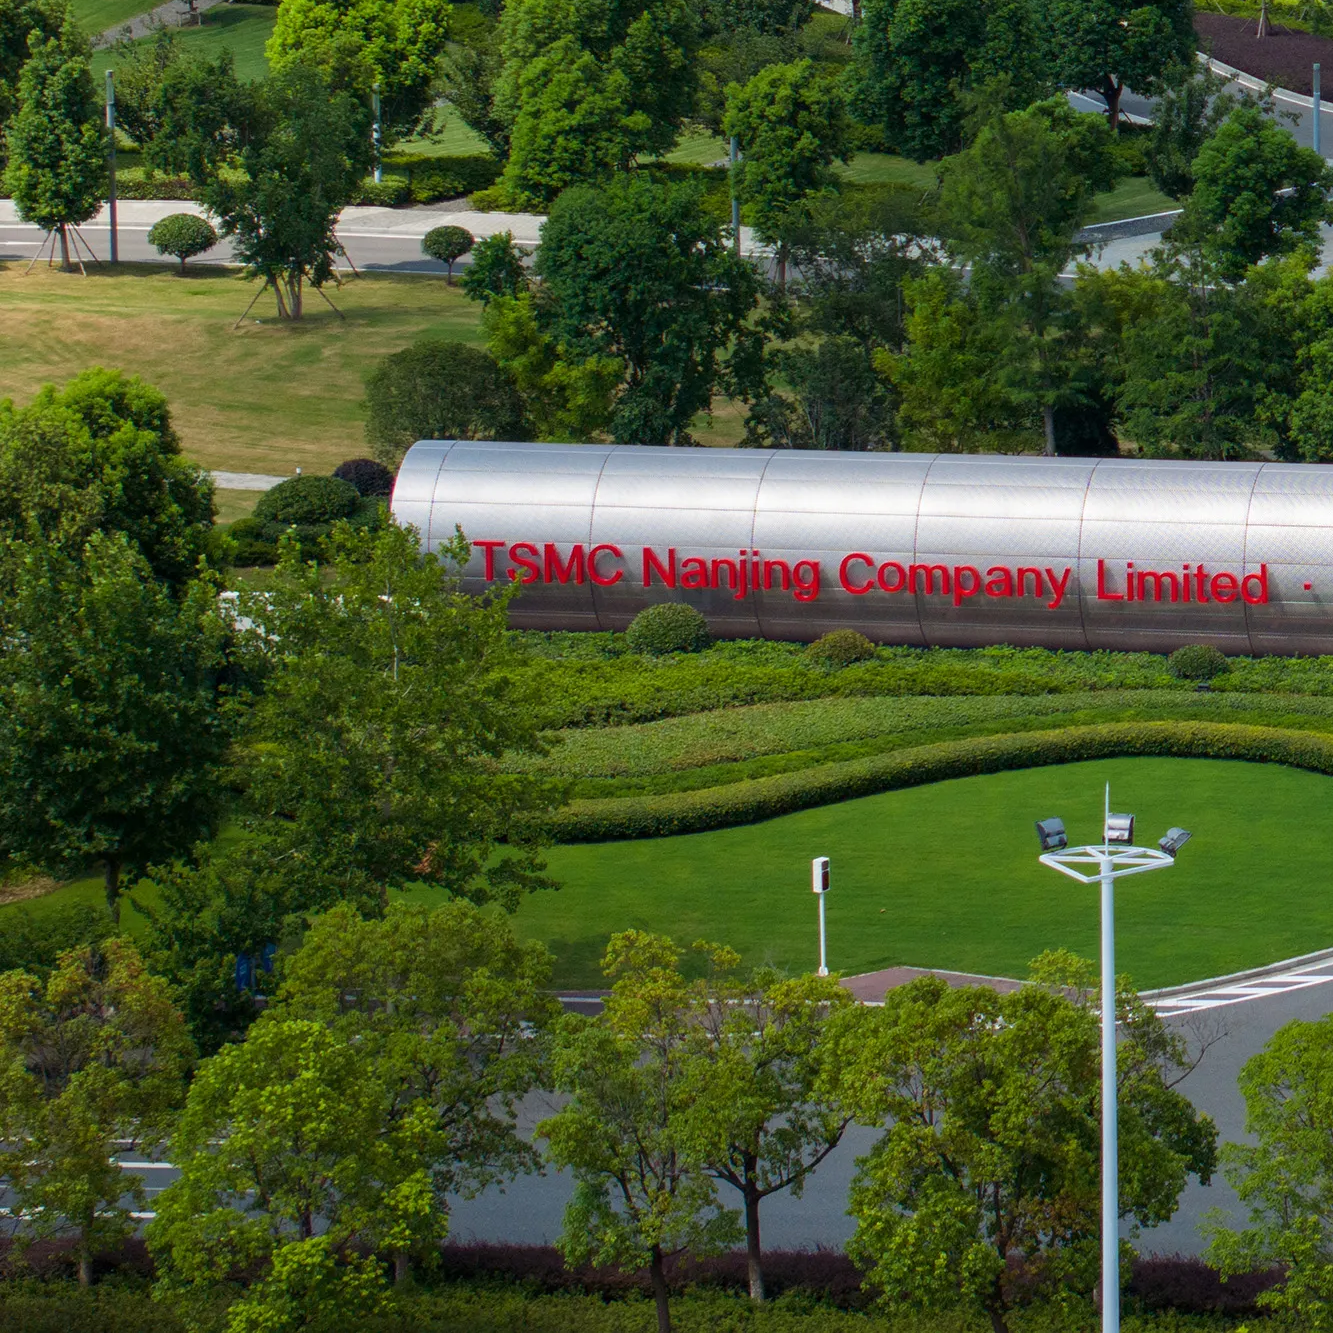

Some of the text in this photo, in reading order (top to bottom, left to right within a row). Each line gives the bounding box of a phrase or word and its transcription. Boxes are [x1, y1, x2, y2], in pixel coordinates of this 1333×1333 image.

[473, 539, 624, 586] TSMC
[643, 547, 821, 602] Nanjing
[839, 553, 1071, 610] Company
[1097, 559, 1269, 605] Limited
